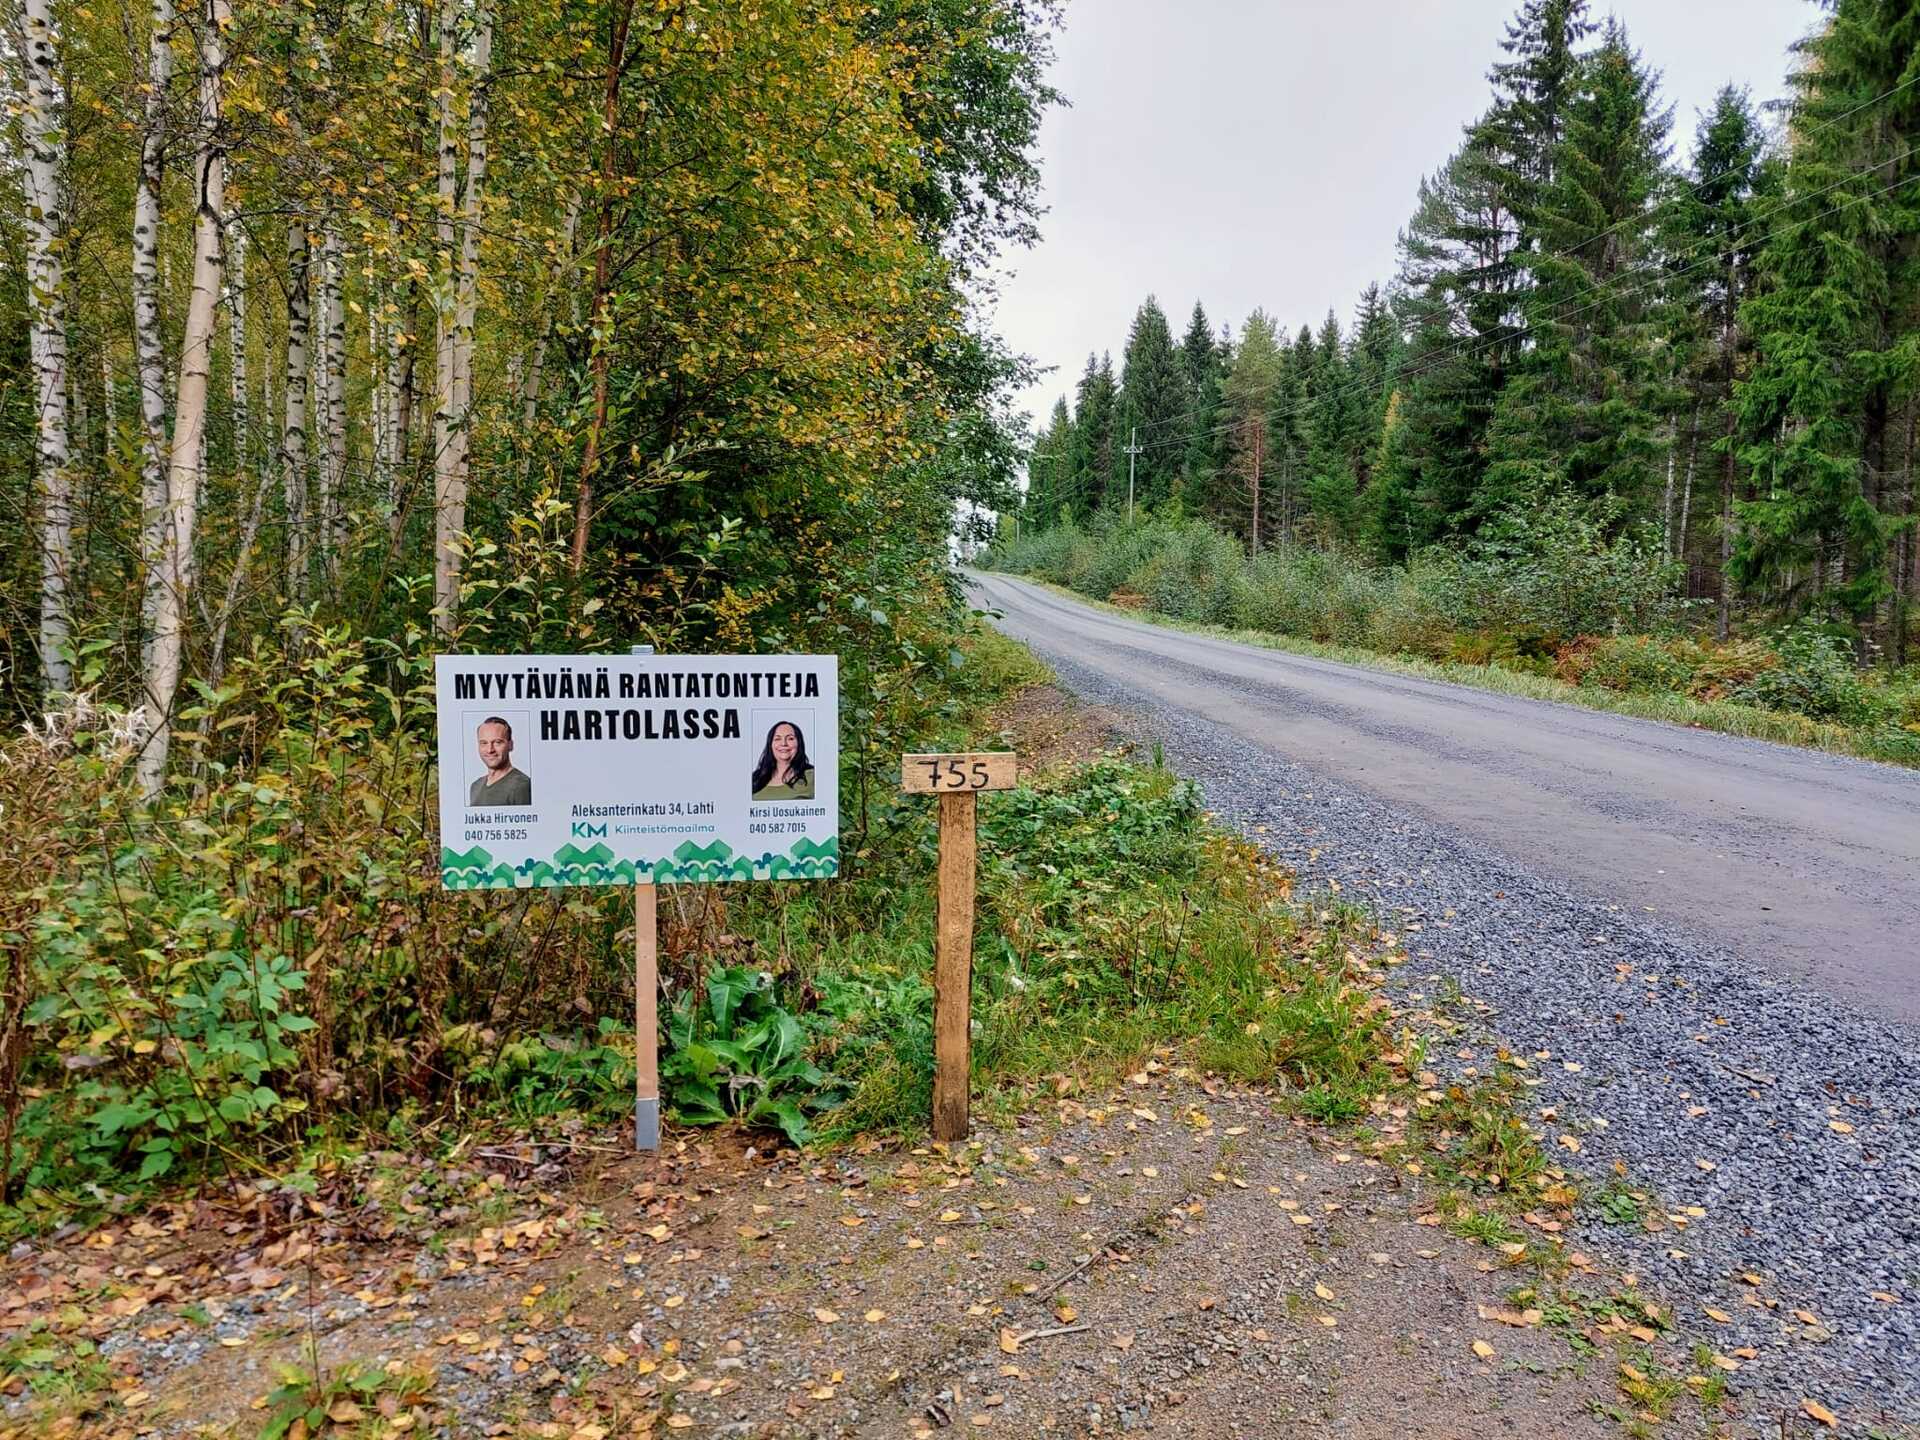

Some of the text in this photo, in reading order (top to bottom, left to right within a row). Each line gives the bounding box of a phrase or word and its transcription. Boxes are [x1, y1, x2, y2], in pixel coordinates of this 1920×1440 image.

[455, 667, 819, 699] MYYTÄVÄNÄ RANTATONTTEJA
[541, 708, 740, 741] HARTOLASSA
[916, 760, 989, 788] 755
[571, 801, 714, 817] Aleksanterinkatu 34, Lahti
[750, 806, 826, 818] Kirsi Uosukainen
[464, 813, 538, 825] Jukka Hirvonen
[465, 829, 527, 841] 040 756 5825
[571, 822, 715, 838] KM Kiinteistömaailma
[749, 822, 806, 834] 040 582 7015
